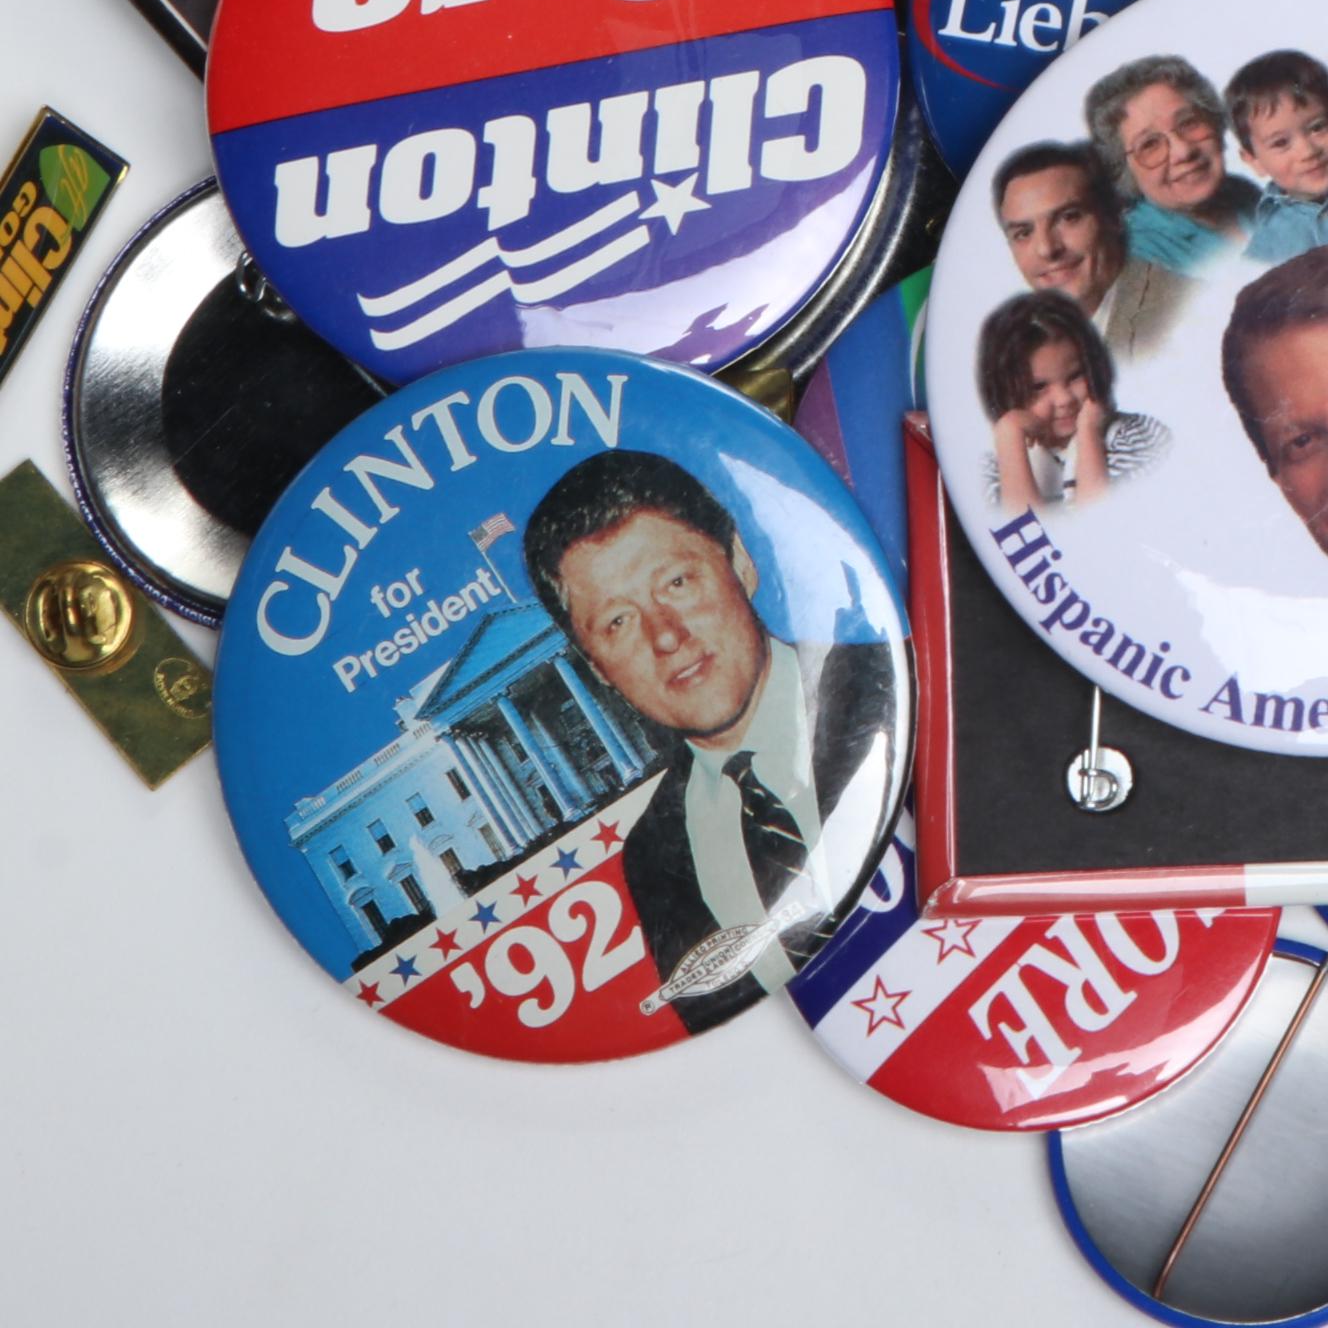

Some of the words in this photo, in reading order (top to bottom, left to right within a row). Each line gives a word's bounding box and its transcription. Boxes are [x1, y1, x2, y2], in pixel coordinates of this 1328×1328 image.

[274, 55, 867, 248] Clinton
[256, 372, 628, 656] CLINTON
[370, 566, 424, 620] for
[989, 505, 1194, 703] Hispanic
[331, 565, 501, 694] President
[968, 911, 1229, 1102] ORE
